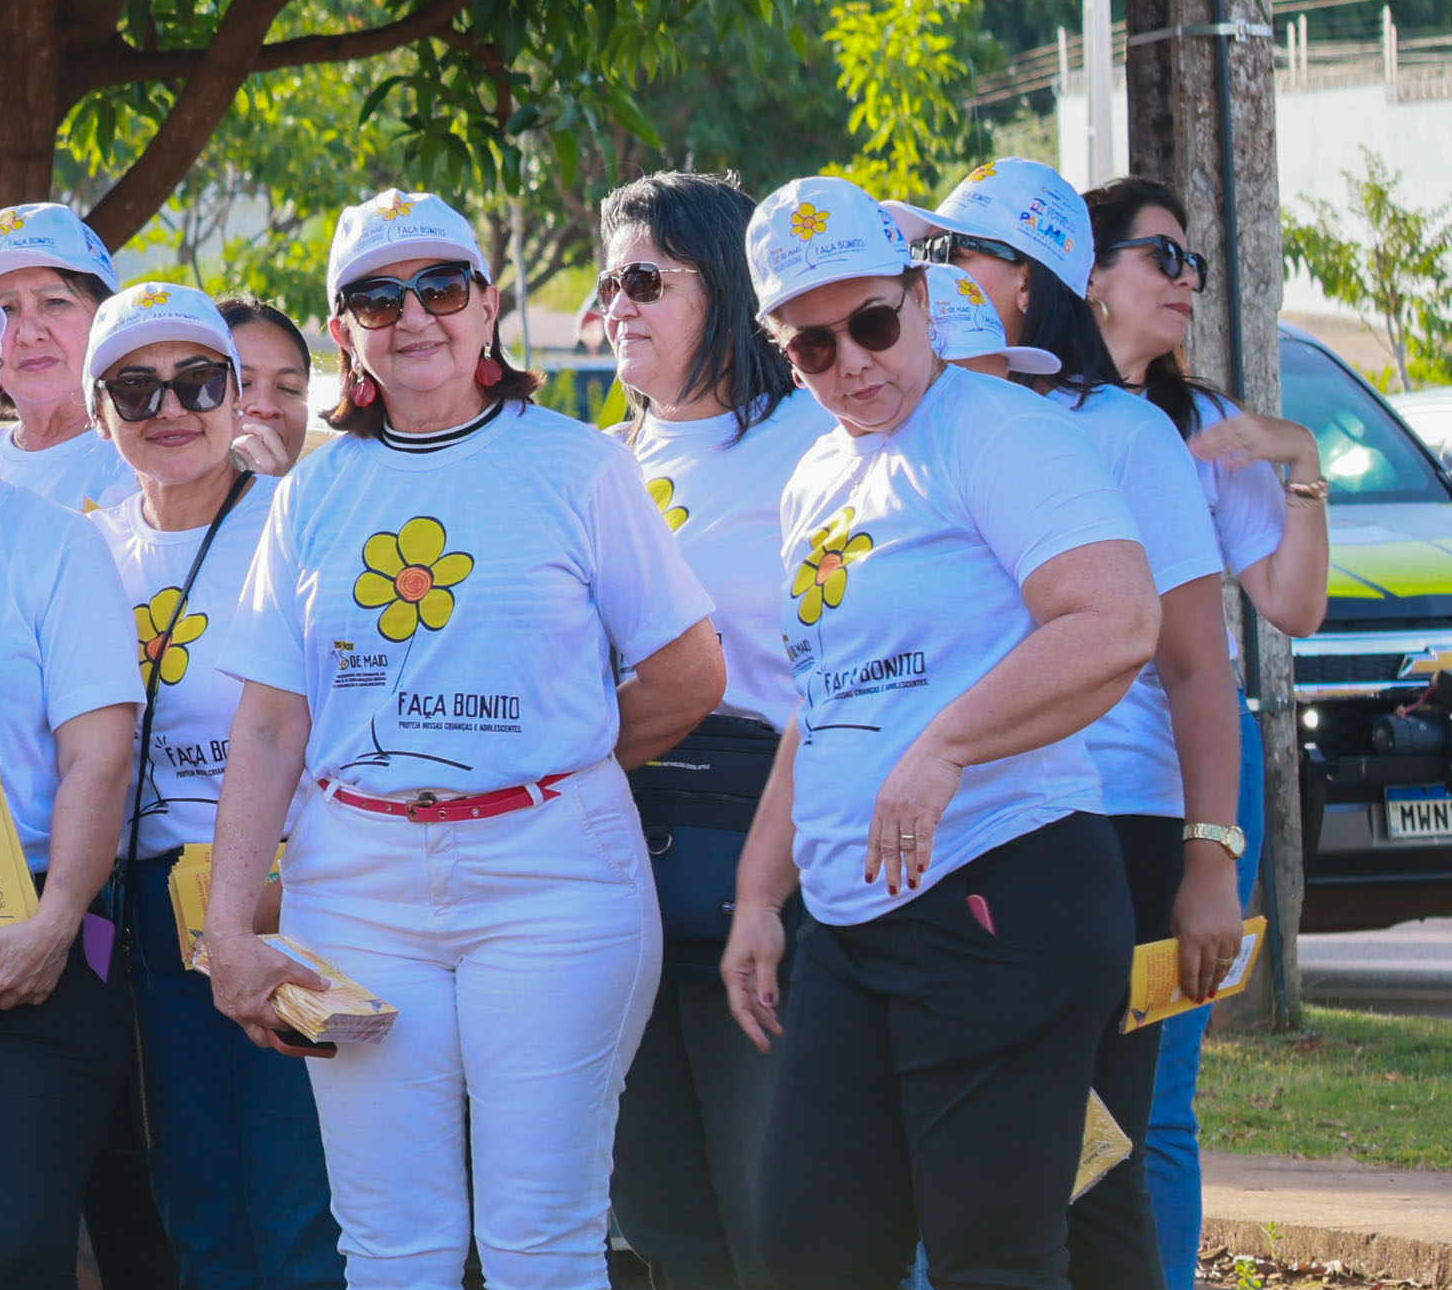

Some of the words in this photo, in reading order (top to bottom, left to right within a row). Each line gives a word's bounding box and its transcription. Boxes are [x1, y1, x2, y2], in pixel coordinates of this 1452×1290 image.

[1019, 211, 1075, 253] PALMAS
[398, 692, 447, 719] FAÇA
[453, 693, 520, 720] BONITO
[1400, 803, 1452, 833] MWN
